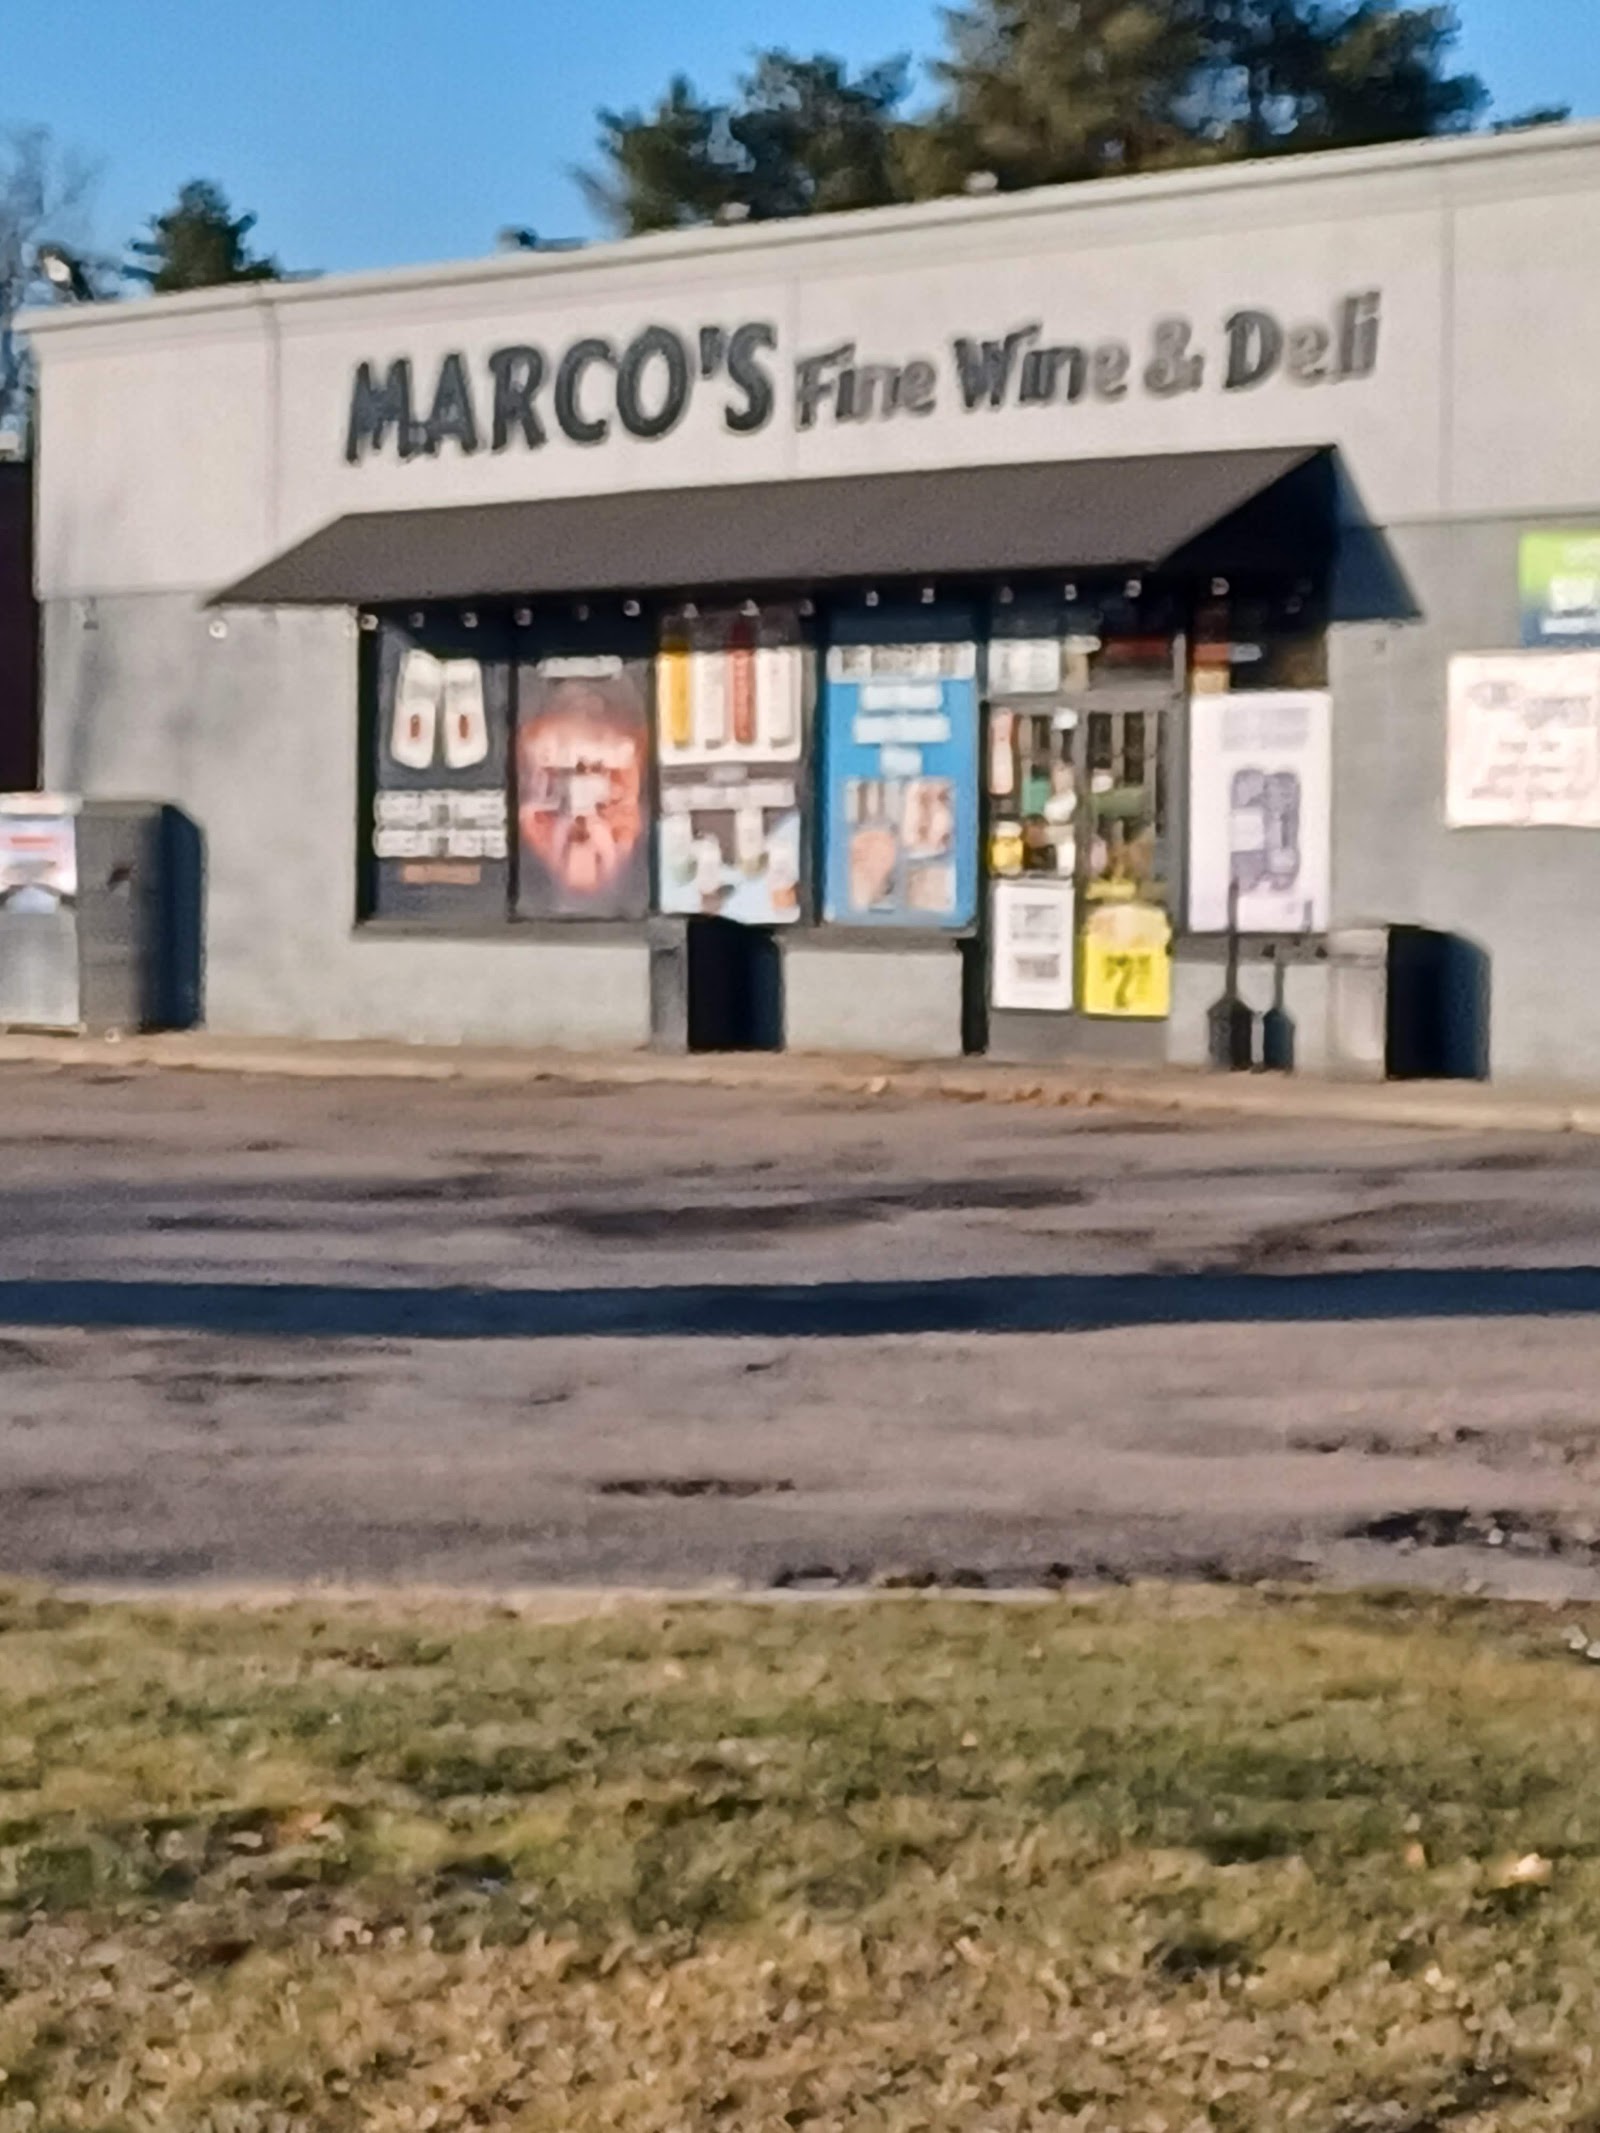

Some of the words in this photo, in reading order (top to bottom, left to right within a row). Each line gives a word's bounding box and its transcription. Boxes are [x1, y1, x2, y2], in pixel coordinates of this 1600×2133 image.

[346, 322, 778, 463] MARCO'S
[795, 343, 937, 431] Fine
[953, 324, 1129, 409] Wine
[1143, 319, 1204, 397] &
[1224, 290, 1381, 390] Deli
